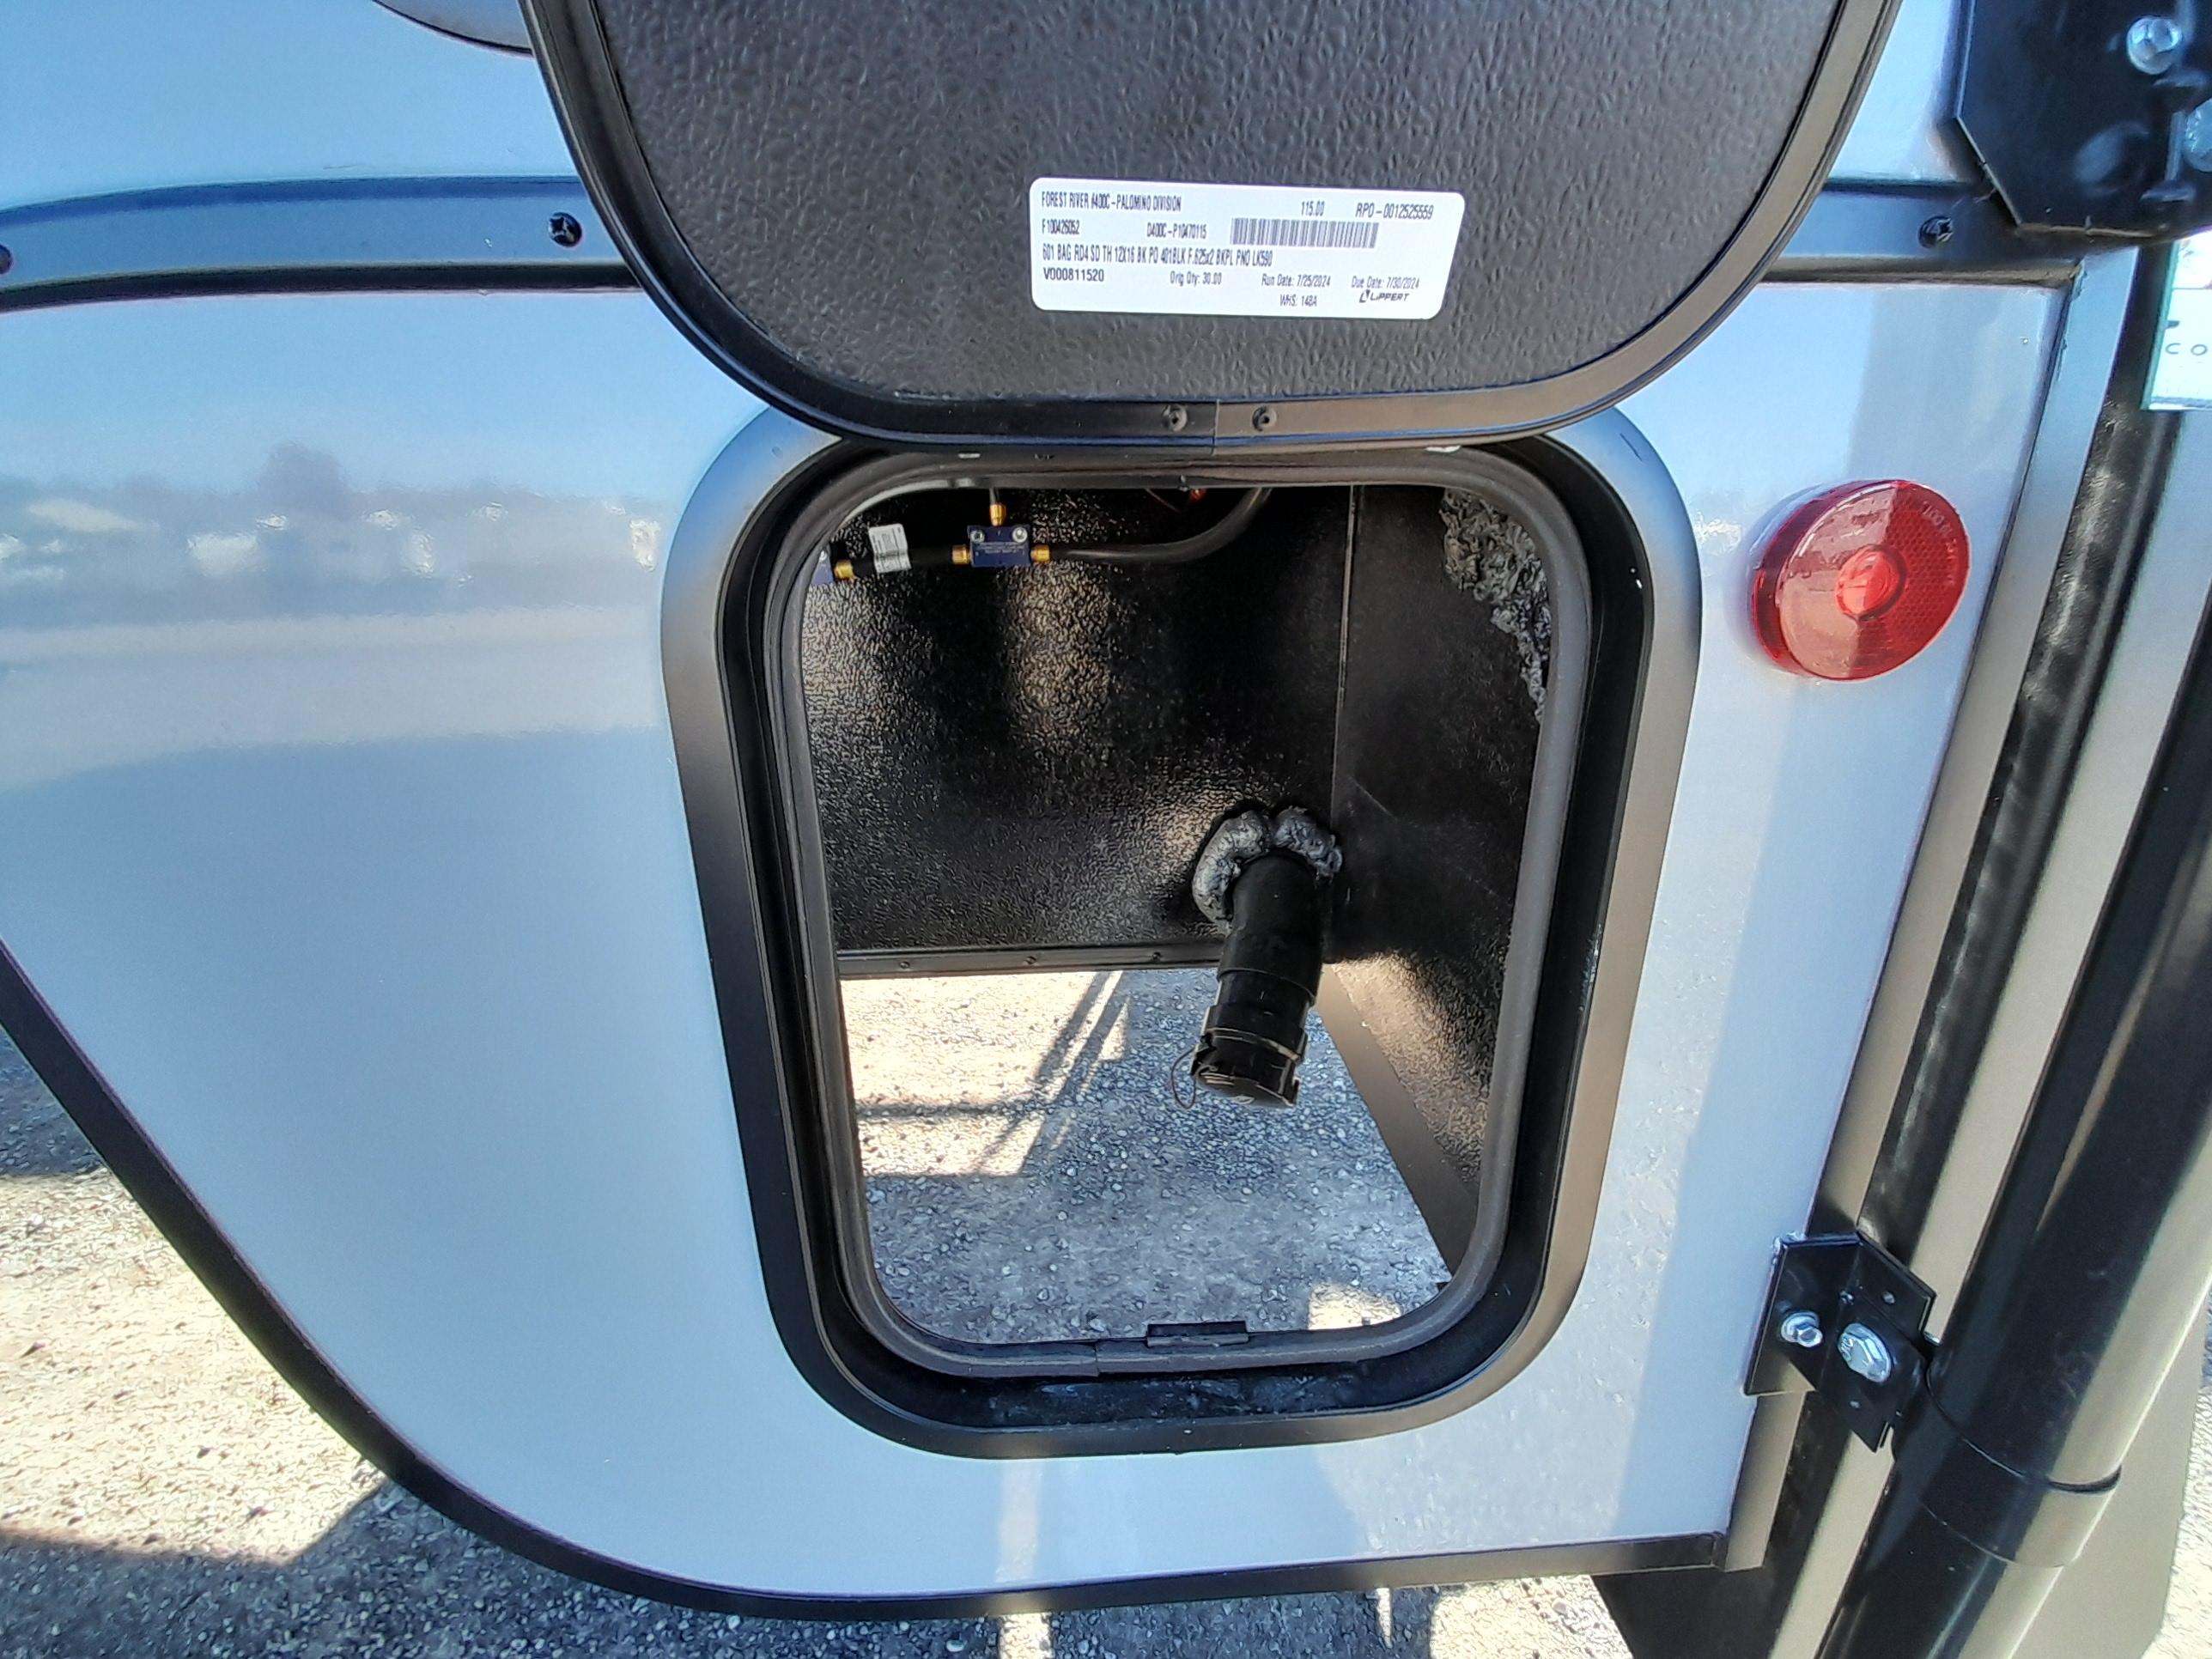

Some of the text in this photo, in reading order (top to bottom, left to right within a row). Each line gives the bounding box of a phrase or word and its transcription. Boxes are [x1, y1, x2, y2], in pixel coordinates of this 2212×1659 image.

[1042, 191, 1067, 208] FOREST
[1069, 192, 1089, 209] RIVER
[1152, 196, 1182, 211] DIVISION
[1301, 200, 1325, 216] 115.00
[1057, 244, 1072, 261] BAG
[1103, 245, 1112, 262] TH
[1137, 246, 1146, 264] BK
[1043, 267, 1104, 282] V000811520
[1170, 270, 1222, 287] Orig Qty: 30.00
[1261, 273, 1331, 288] Run Date: 7/25/2024
[1351, 276, 1419, 289] Due Date: 7/30/2024
[1279, 294, 1297, 307] WHS:
[1370, 293, 1410, 301] LIPPERT
